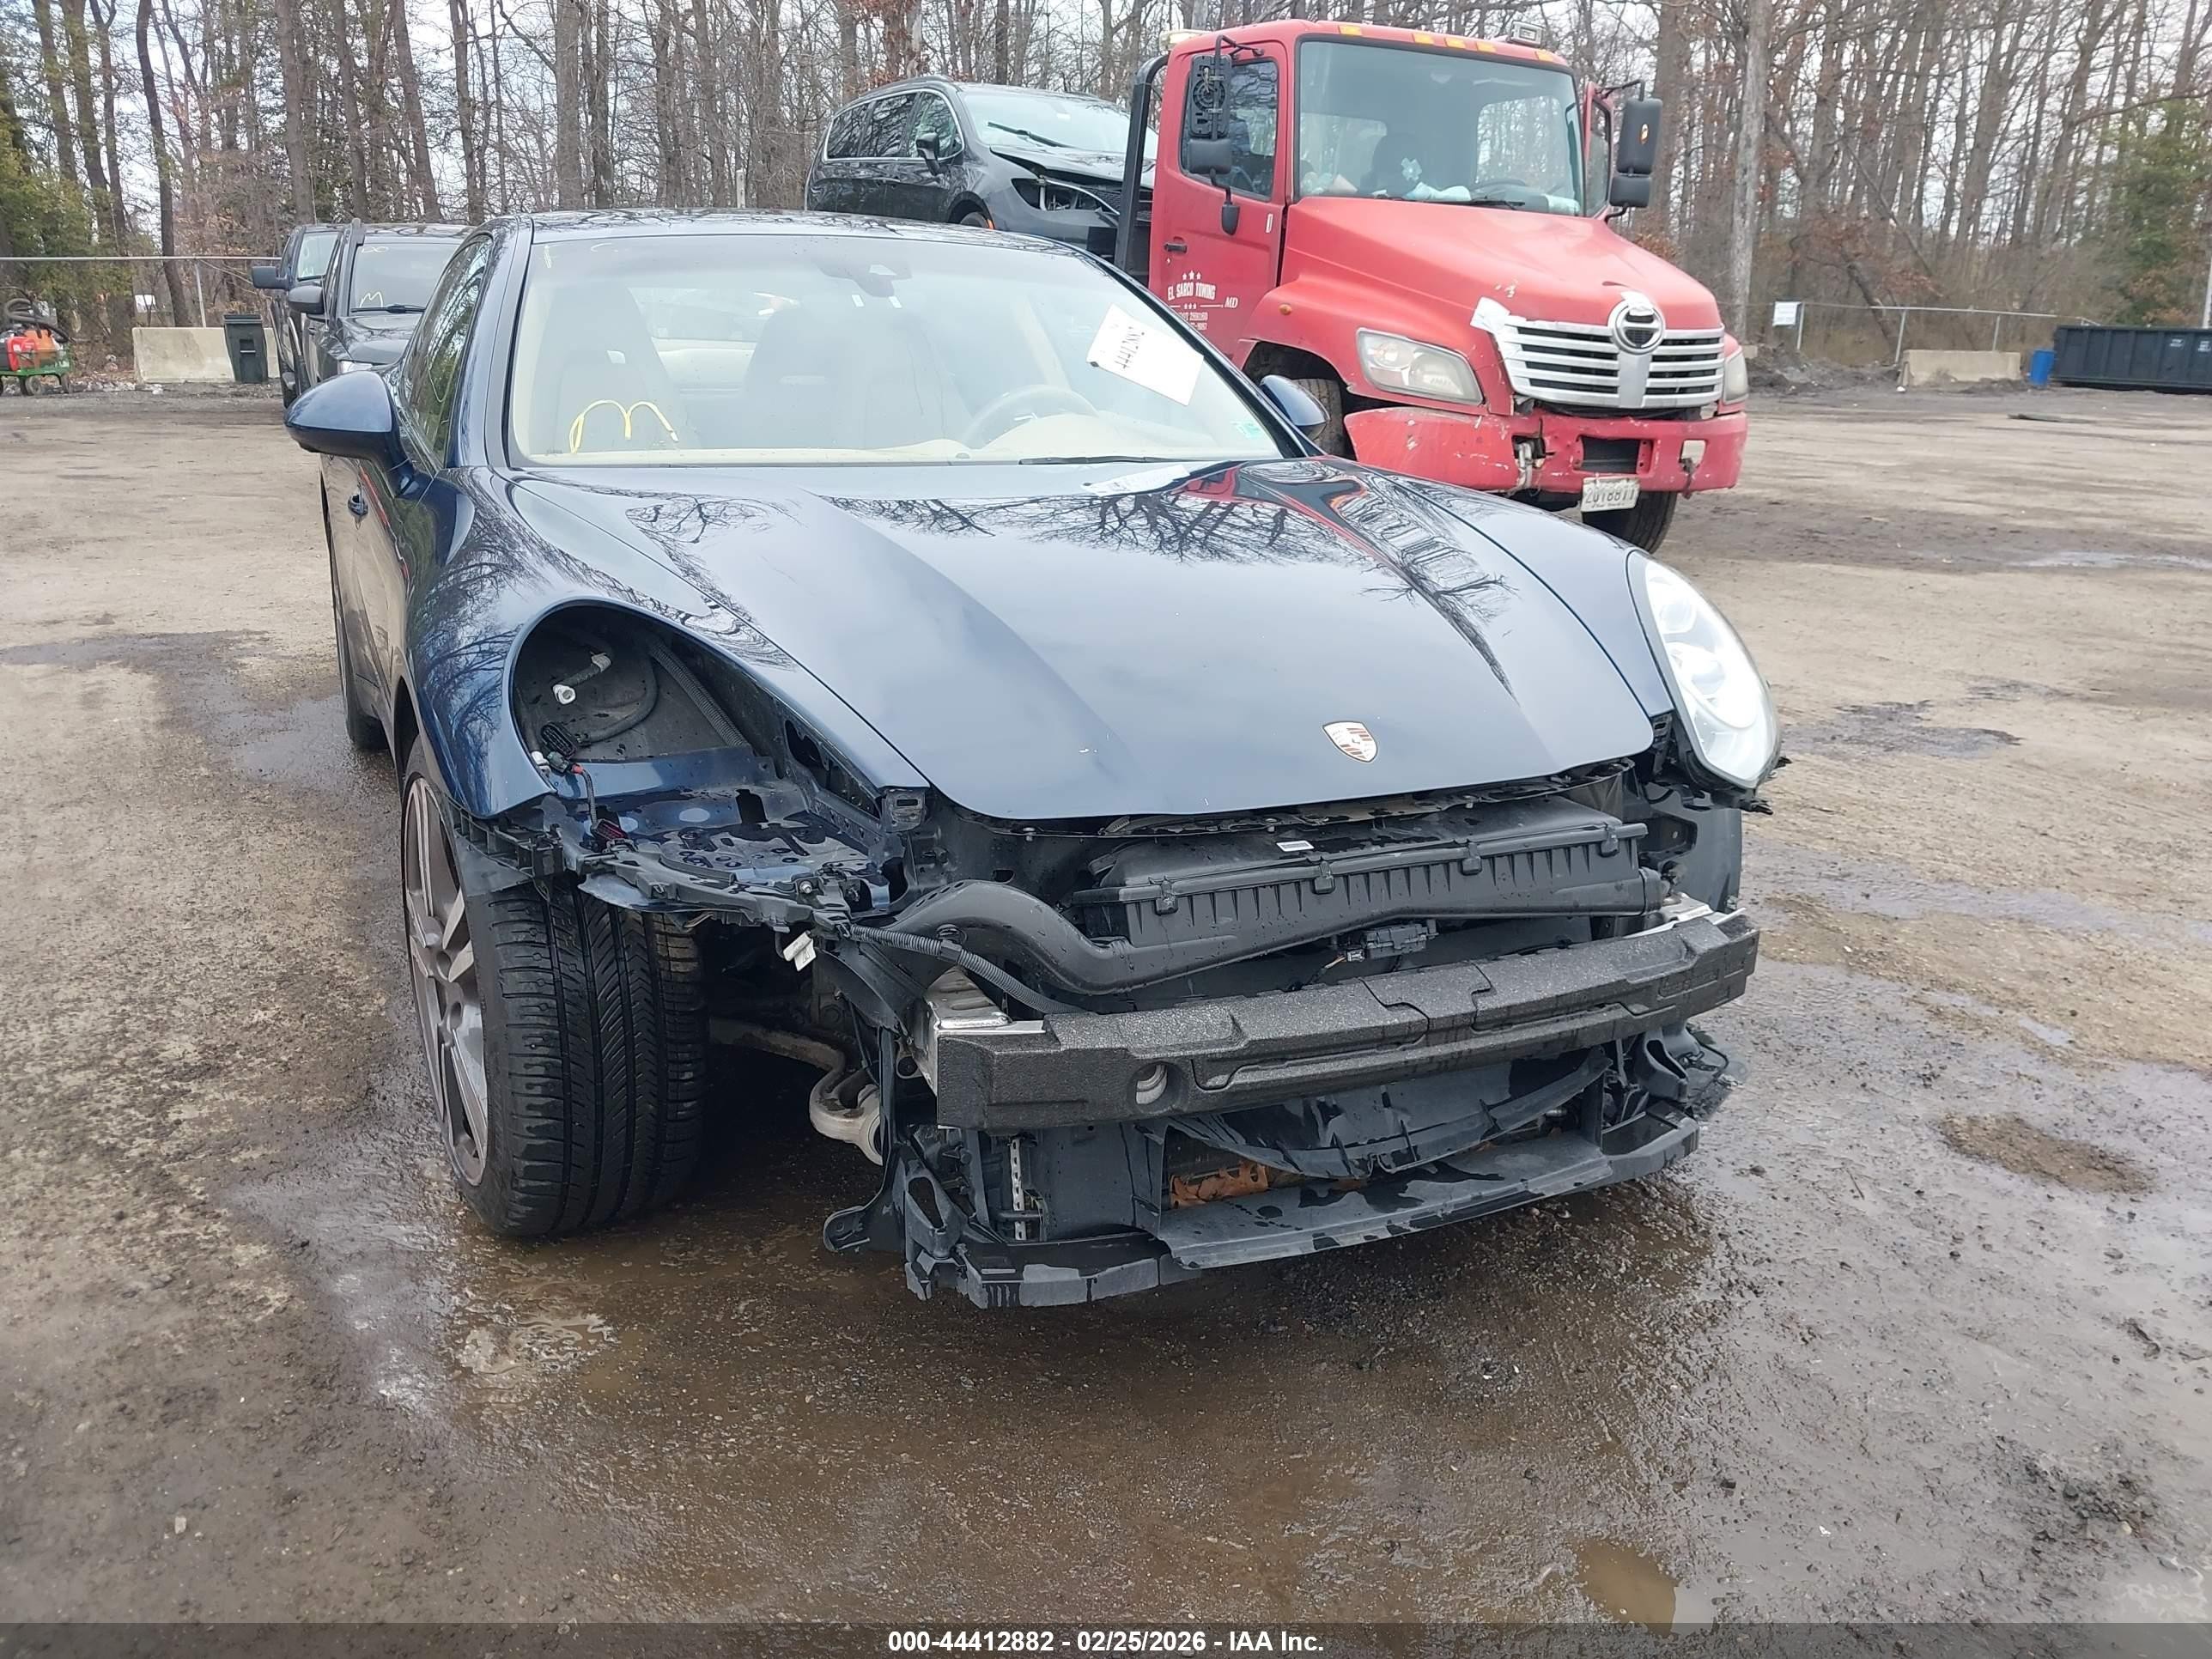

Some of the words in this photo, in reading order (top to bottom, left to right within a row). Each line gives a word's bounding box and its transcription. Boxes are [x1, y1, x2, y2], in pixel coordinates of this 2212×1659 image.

[1167, 285, 1176, 301] EL
[1195, 283, 1216, 300] TOWING
[1224, 296, 1238, 308] MD
